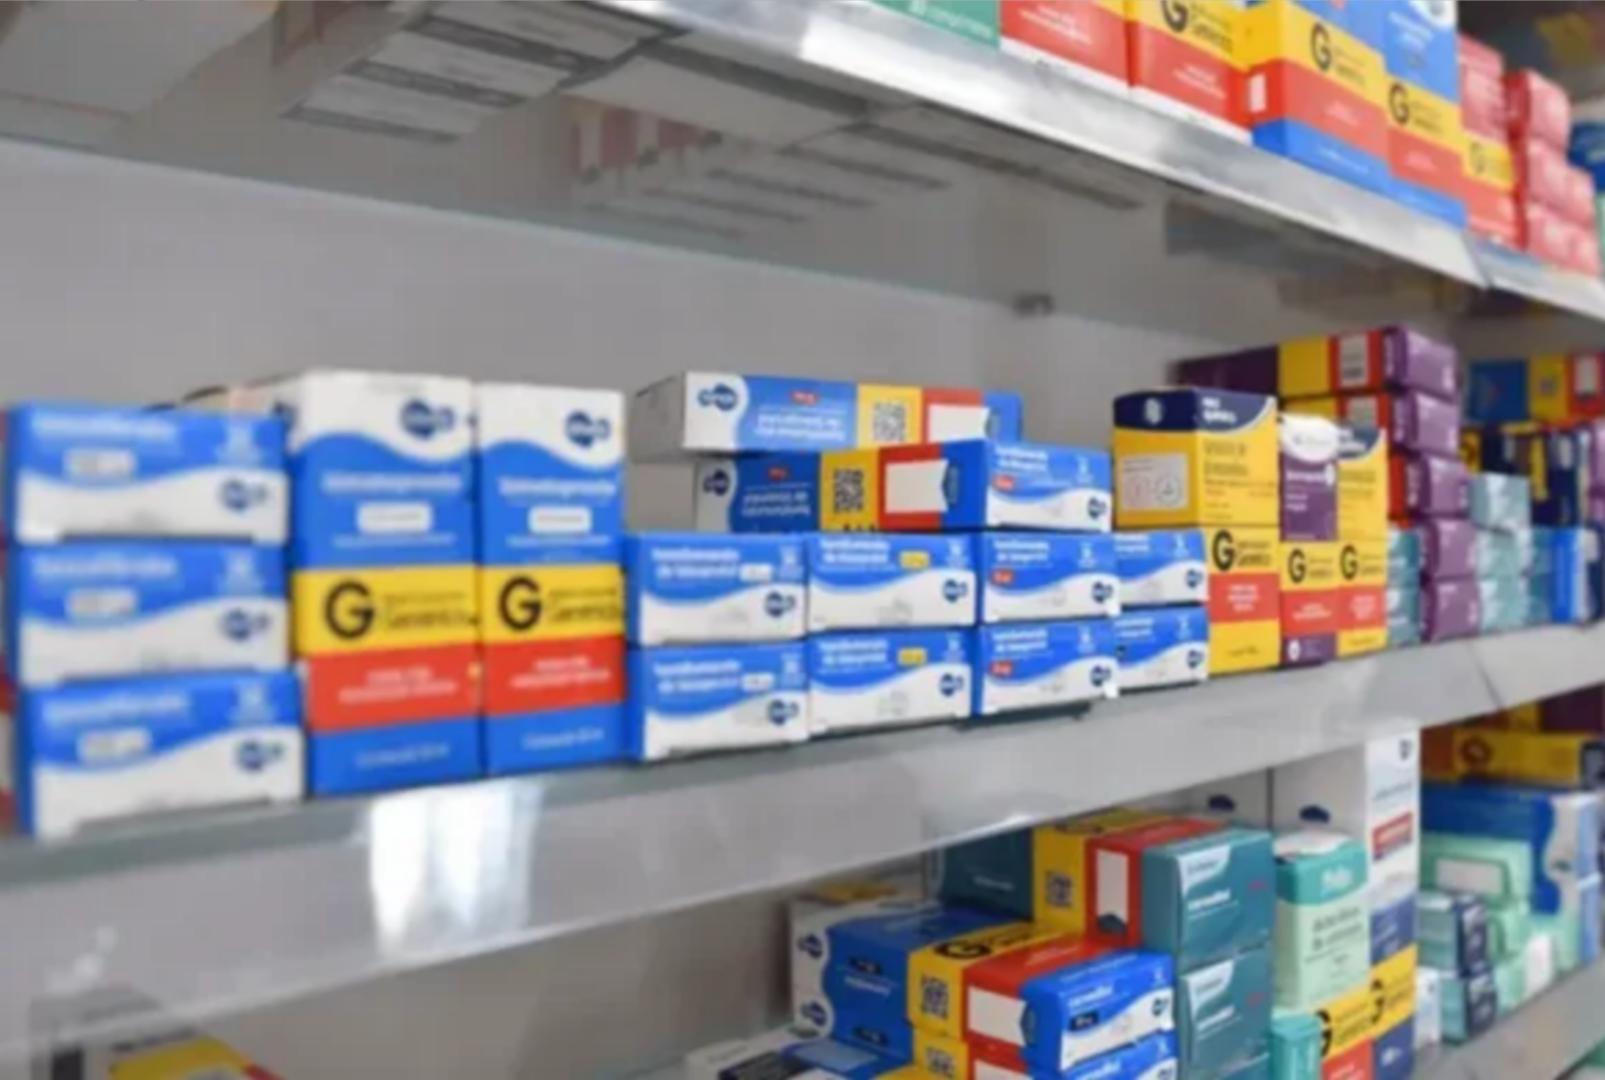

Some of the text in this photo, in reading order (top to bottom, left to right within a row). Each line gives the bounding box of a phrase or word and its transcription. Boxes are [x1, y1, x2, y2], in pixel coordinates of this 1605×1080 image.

[1161, 0, 1188, 33] G
[1311, 22, 1333, 72] G
[1388, 83, 1410, 125] G
[1212, 529, 1236, 572] G
[1288, 548, 1308, 585] G
[1340, 545, 1360, 581] G
[324, 579, 375, 640] G
[498, 575, 543, 632] G
